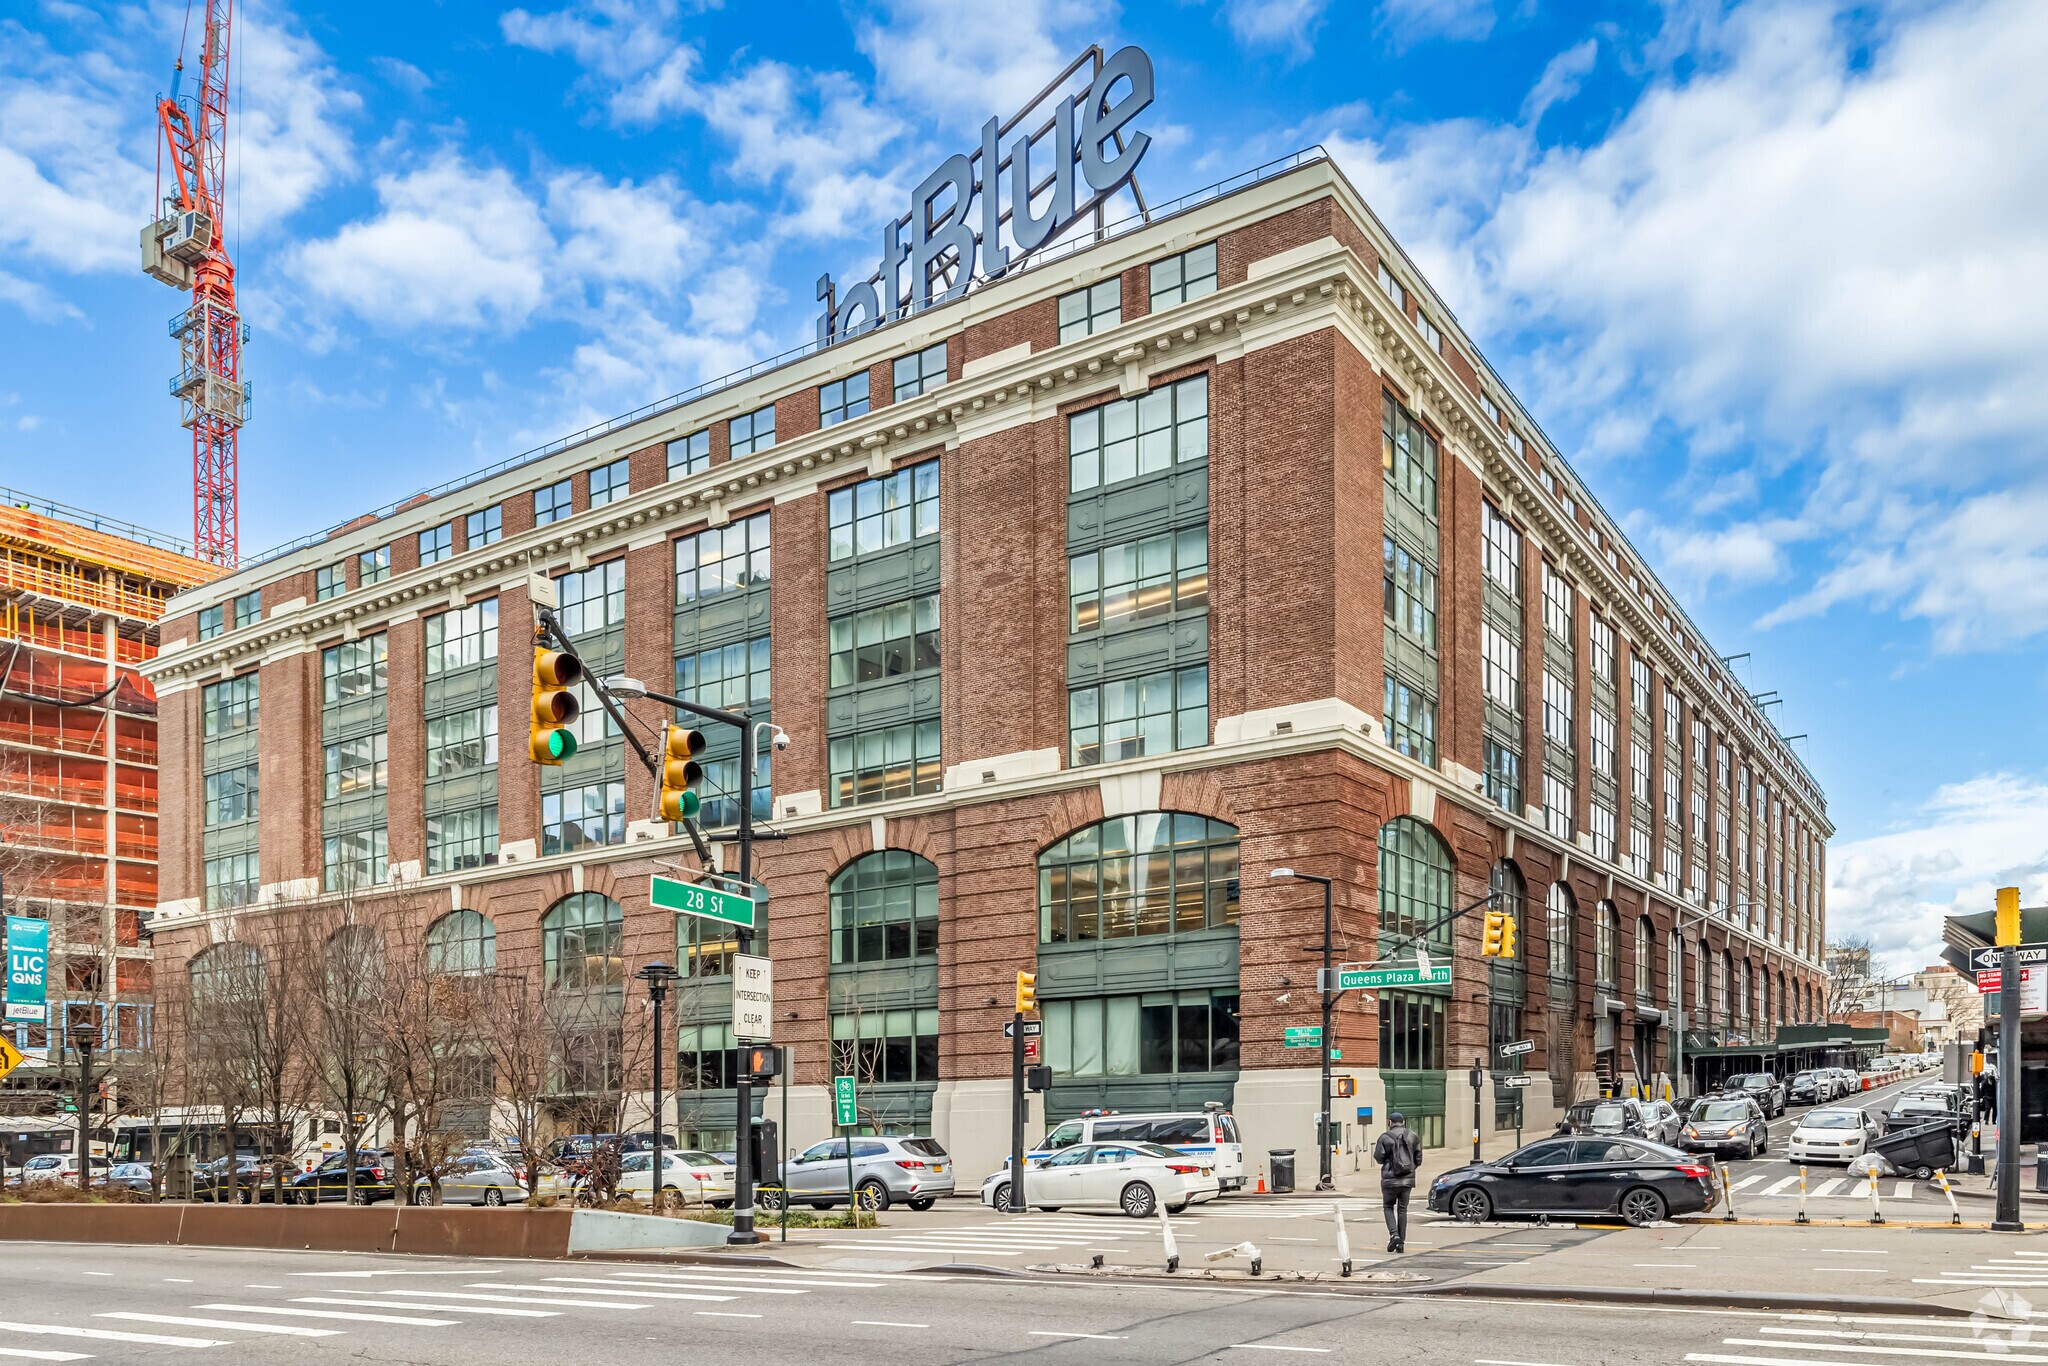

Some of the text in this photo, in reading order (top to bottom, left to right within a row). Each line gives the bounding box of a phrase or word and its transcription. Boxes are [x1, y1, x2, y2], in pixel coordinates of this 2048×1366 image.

[686, 890, 724, 914] 28 St
[2017, 950, 2041, 960] WAY
[12, 954, 44, 972] LIC
[12, 972, 42, 985] QNS
[745, 969, 761, 979] KEEP
[1343, 970, 1448, 986] Queens Plaza rth
[736, 990, 771, 1003] INTERSECTION
[12, 1006, 38, 1015] jetBlue
[744, 1013, 762, 1024] CLEAR
